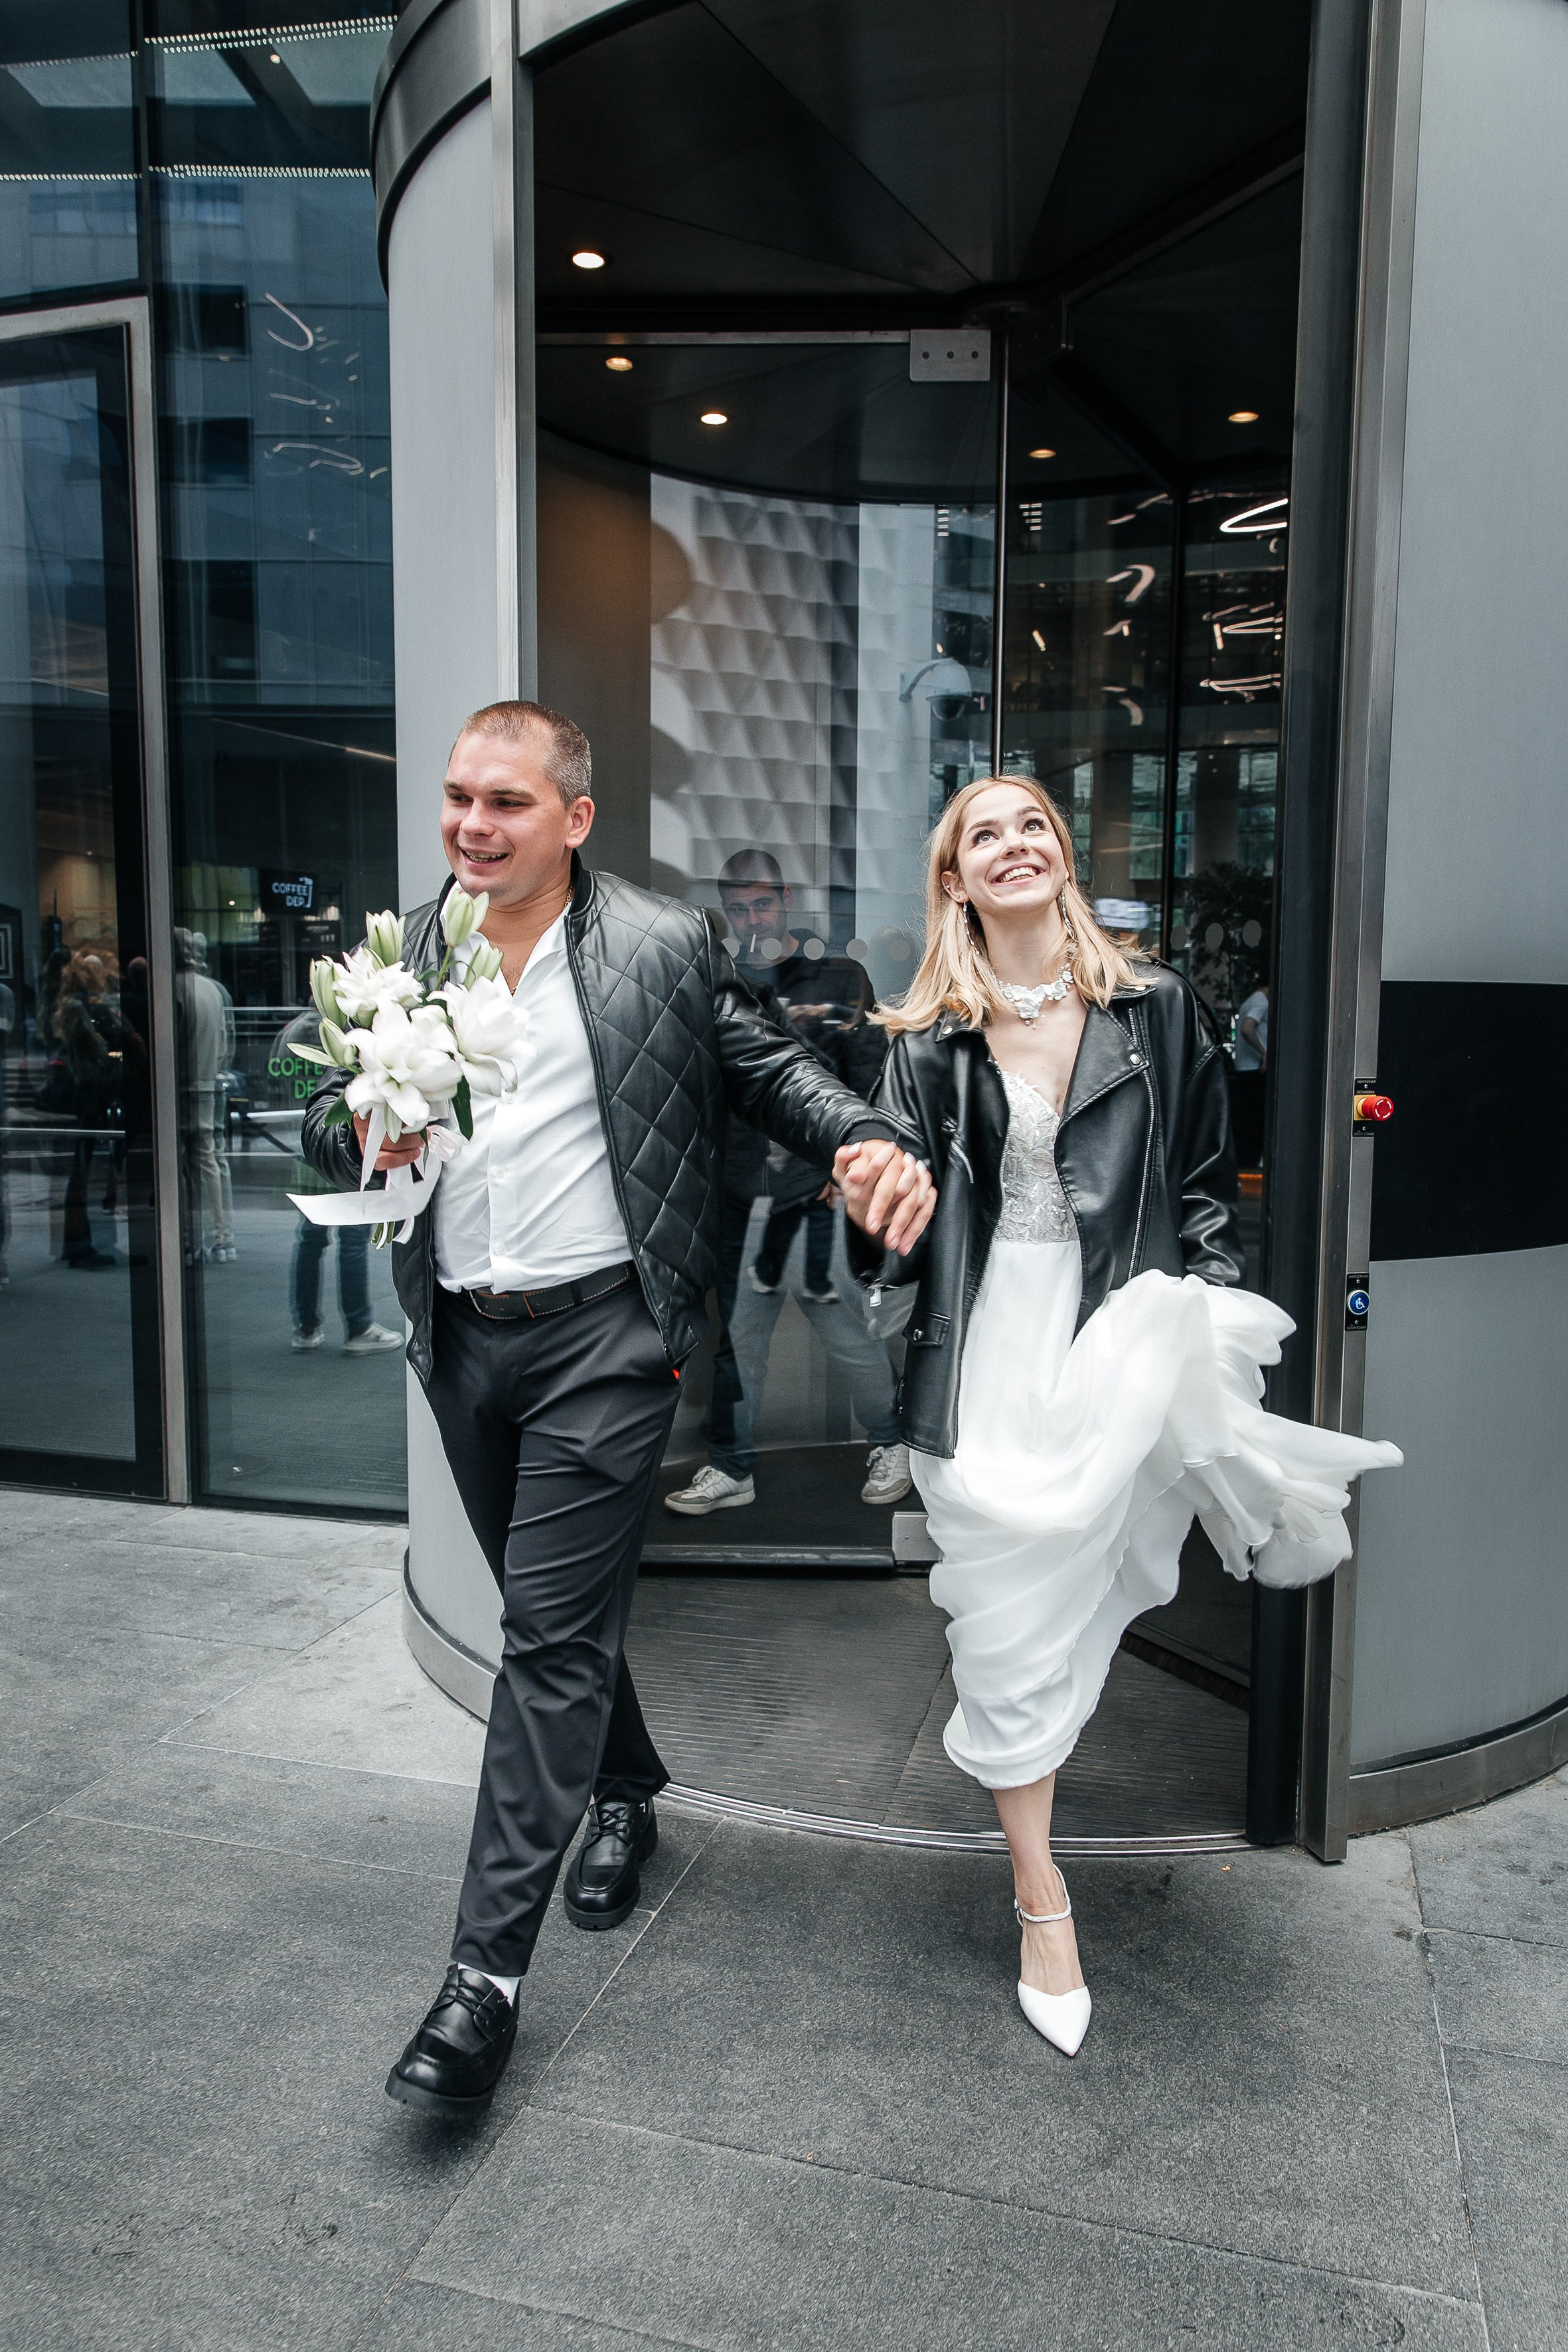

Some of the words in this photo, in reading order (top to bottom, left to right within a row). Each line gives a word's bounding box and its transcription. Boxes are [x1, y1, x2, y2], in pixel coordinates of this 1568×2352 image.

[272, 882, 308, 896] COFFEE
[268, 1057, 324, 1077] COFFE
[294, 1079, 318, 1099] DE
